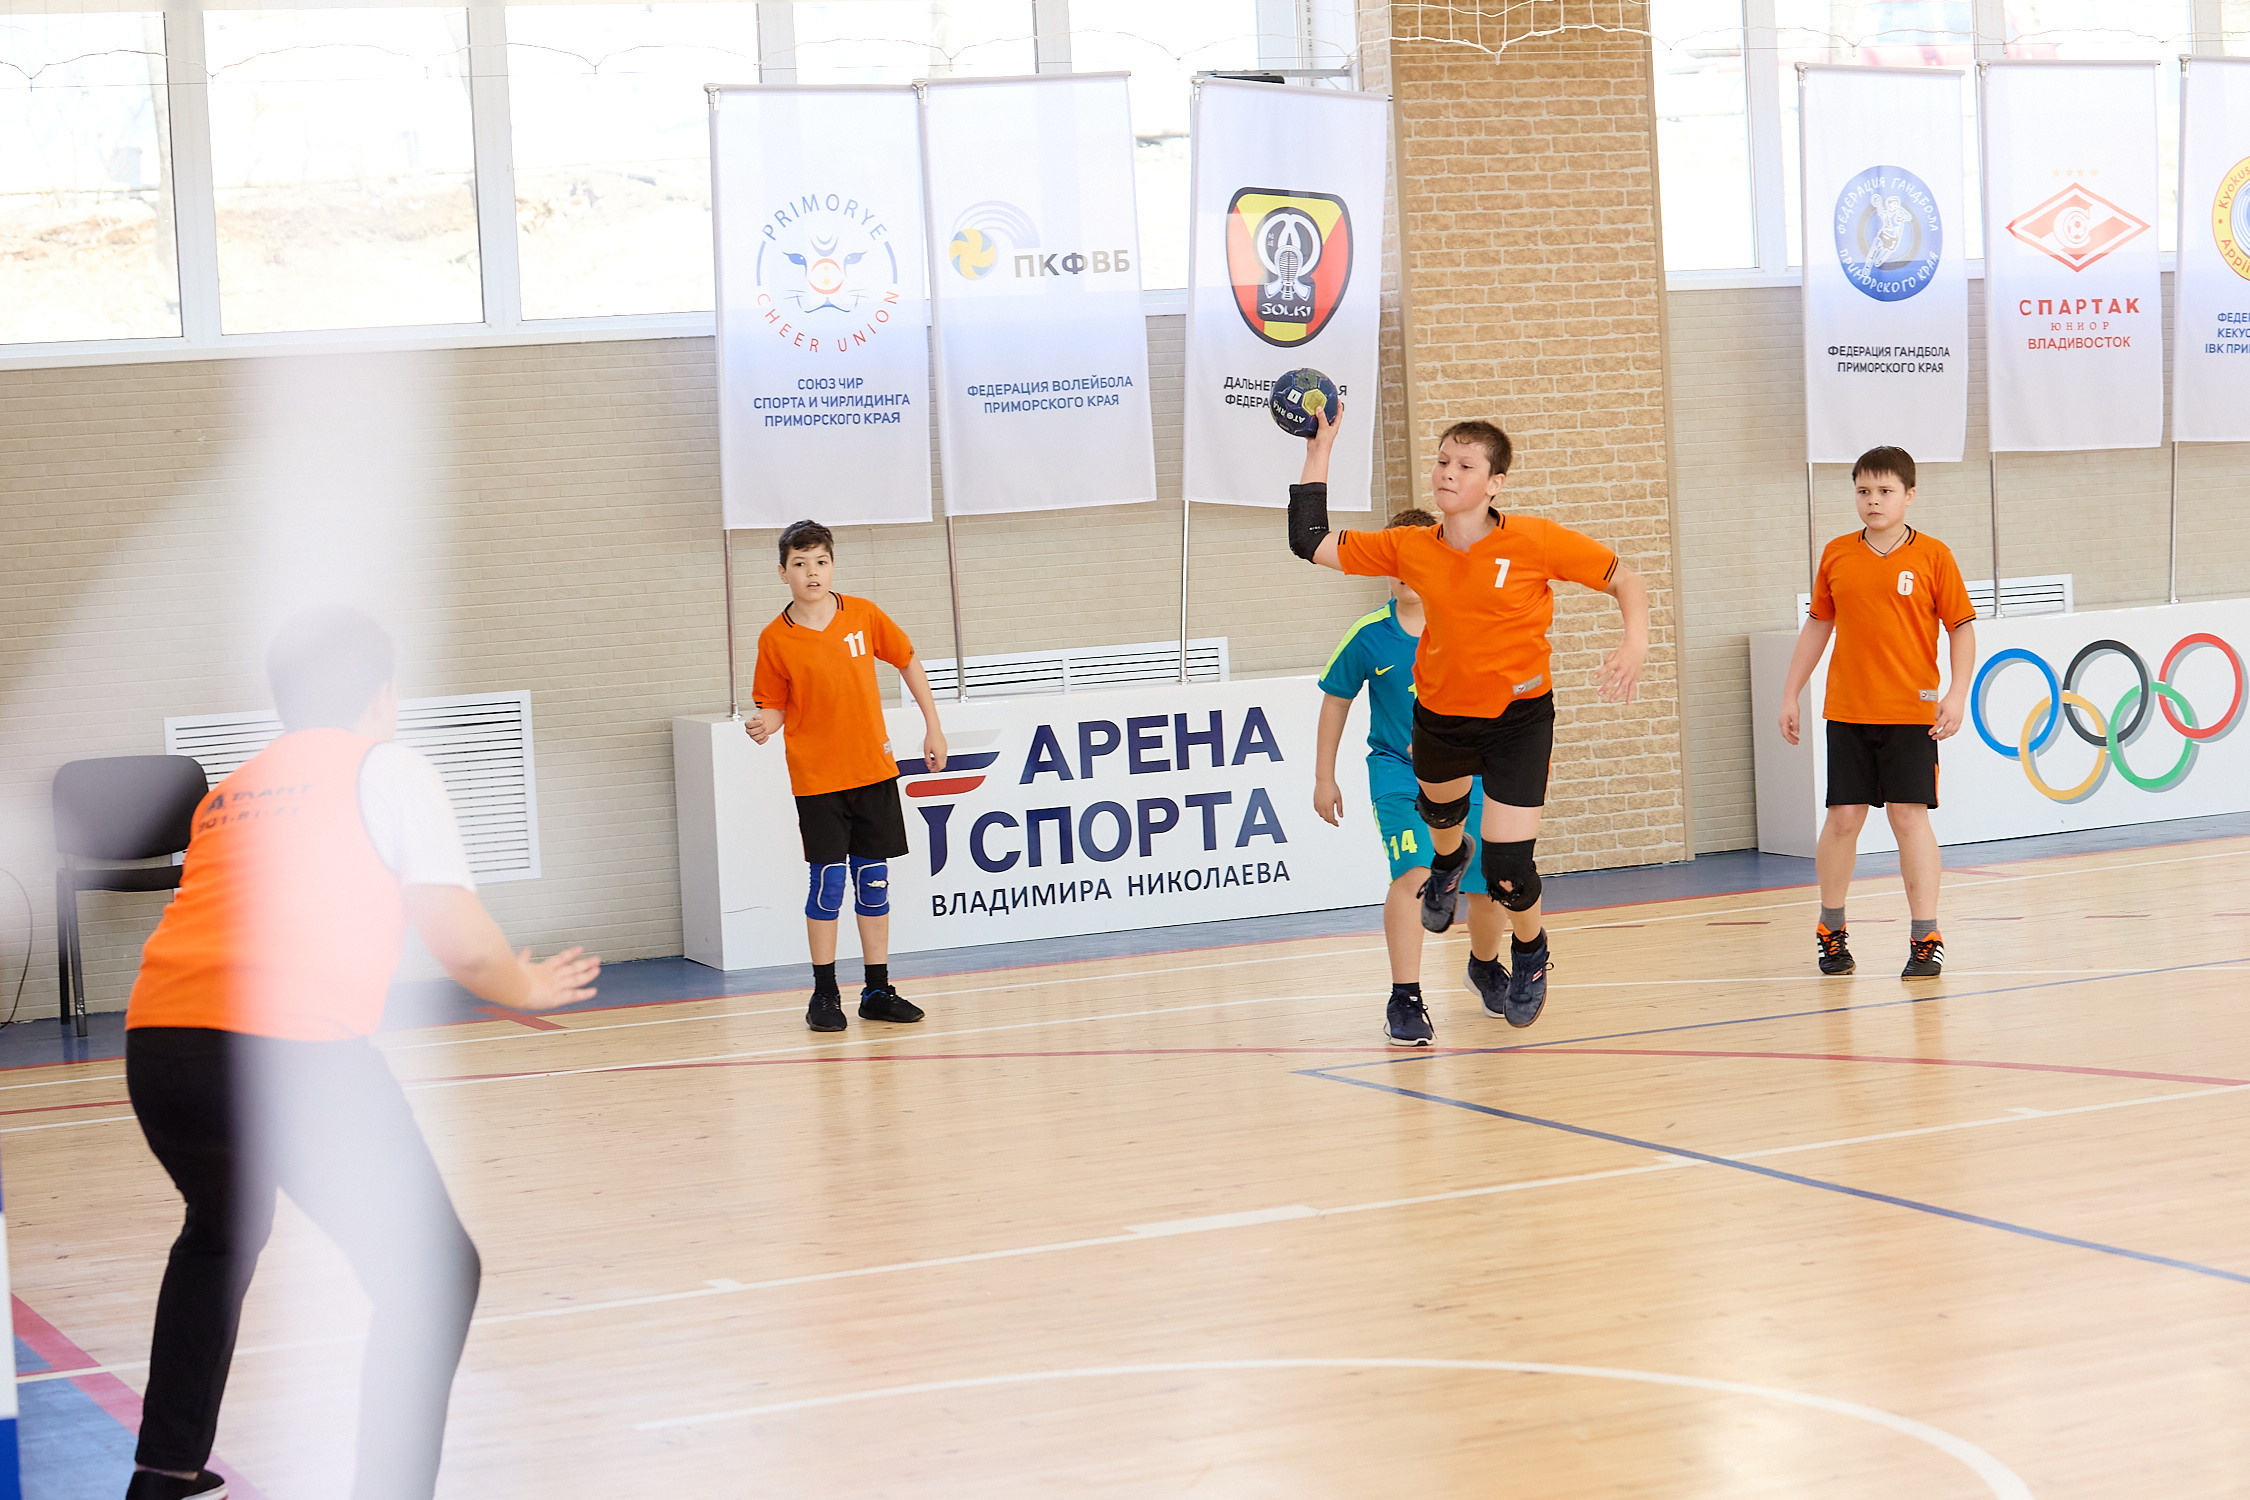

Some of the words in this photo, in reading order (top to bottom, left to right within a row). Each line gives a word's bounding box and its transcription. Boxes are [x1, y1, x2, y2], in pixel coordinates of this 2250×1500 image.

[762, 193, 887, 241] PRIMORYE
[1837, 176, 1886, 235] ФЕДЕРАЦИЯ
[1891, 177, 1939, 232] ГАНДБОЛА
[1014, 249, 1131, 278] ПКФВБ
[1839, 248, 1917, 293] ПРИМОРСКОГО
[1917, 251, 1939, 281] КРАЯ
[1261, 302, 1312, 317] SOLKI
[2019, 298, 2140, 316] СПАРТАК
[2217, 312, 2250, 324] ФЕДЕ
[757, 293, 819, 352] CHEER
[838, 291, 900, 352] UNION
[2051, 321, 2110, 331] ЮНИОР
[1828, 345, 1891, 359] ФЕДЕРАЦИЯ
[1894, 346, 1950, 359] ГАНДБОЛА
[2028, 336, 2131, 351] ВЛАДИВОСТОК
[2226, 343, 2250, 354] ПРИ
[1837, 362, 1916, 373] ПРИМОРСКОГО
[1918, 362, 1944, 373] КРАЯ
[798, 378, 836, 390] СОЮЗ
[839, 378, 864, 389] ЧИР
[967, 381, 1049, 398] ФЕДЕРАЦИЯ
[1052, 375, 1134, 392] ВОЛЕЙБОЛА
[753, 397, 806, 409] СПОРТА
[808, 396, 818, 408] И
[821, 394, 911, 409] ЧИРЛИДИНГА
[984, 396, 1084, 414] ПРИМОРСКОГО
[1087, 394, 1120, 407] КРАЯ
[765, 413, 861, 427] ПРИМОРСКОГО
[864, 412, 901, 424] КРАЯ
[1494, 558, 1511, 588] 7
[1897, 570, 1915, 596] 6
[843, 630, 866, 657] 11
[1019, 706, 1284, 785] АРЕНА
[969, 787, 1288, 873] СПОРТА
[1390, 829, 1418, 861] 14
[931, 878, 1112, 917] ВЛАДИМИРА
[1127, 860, 1291, 898] НИКОЛАЕВА
